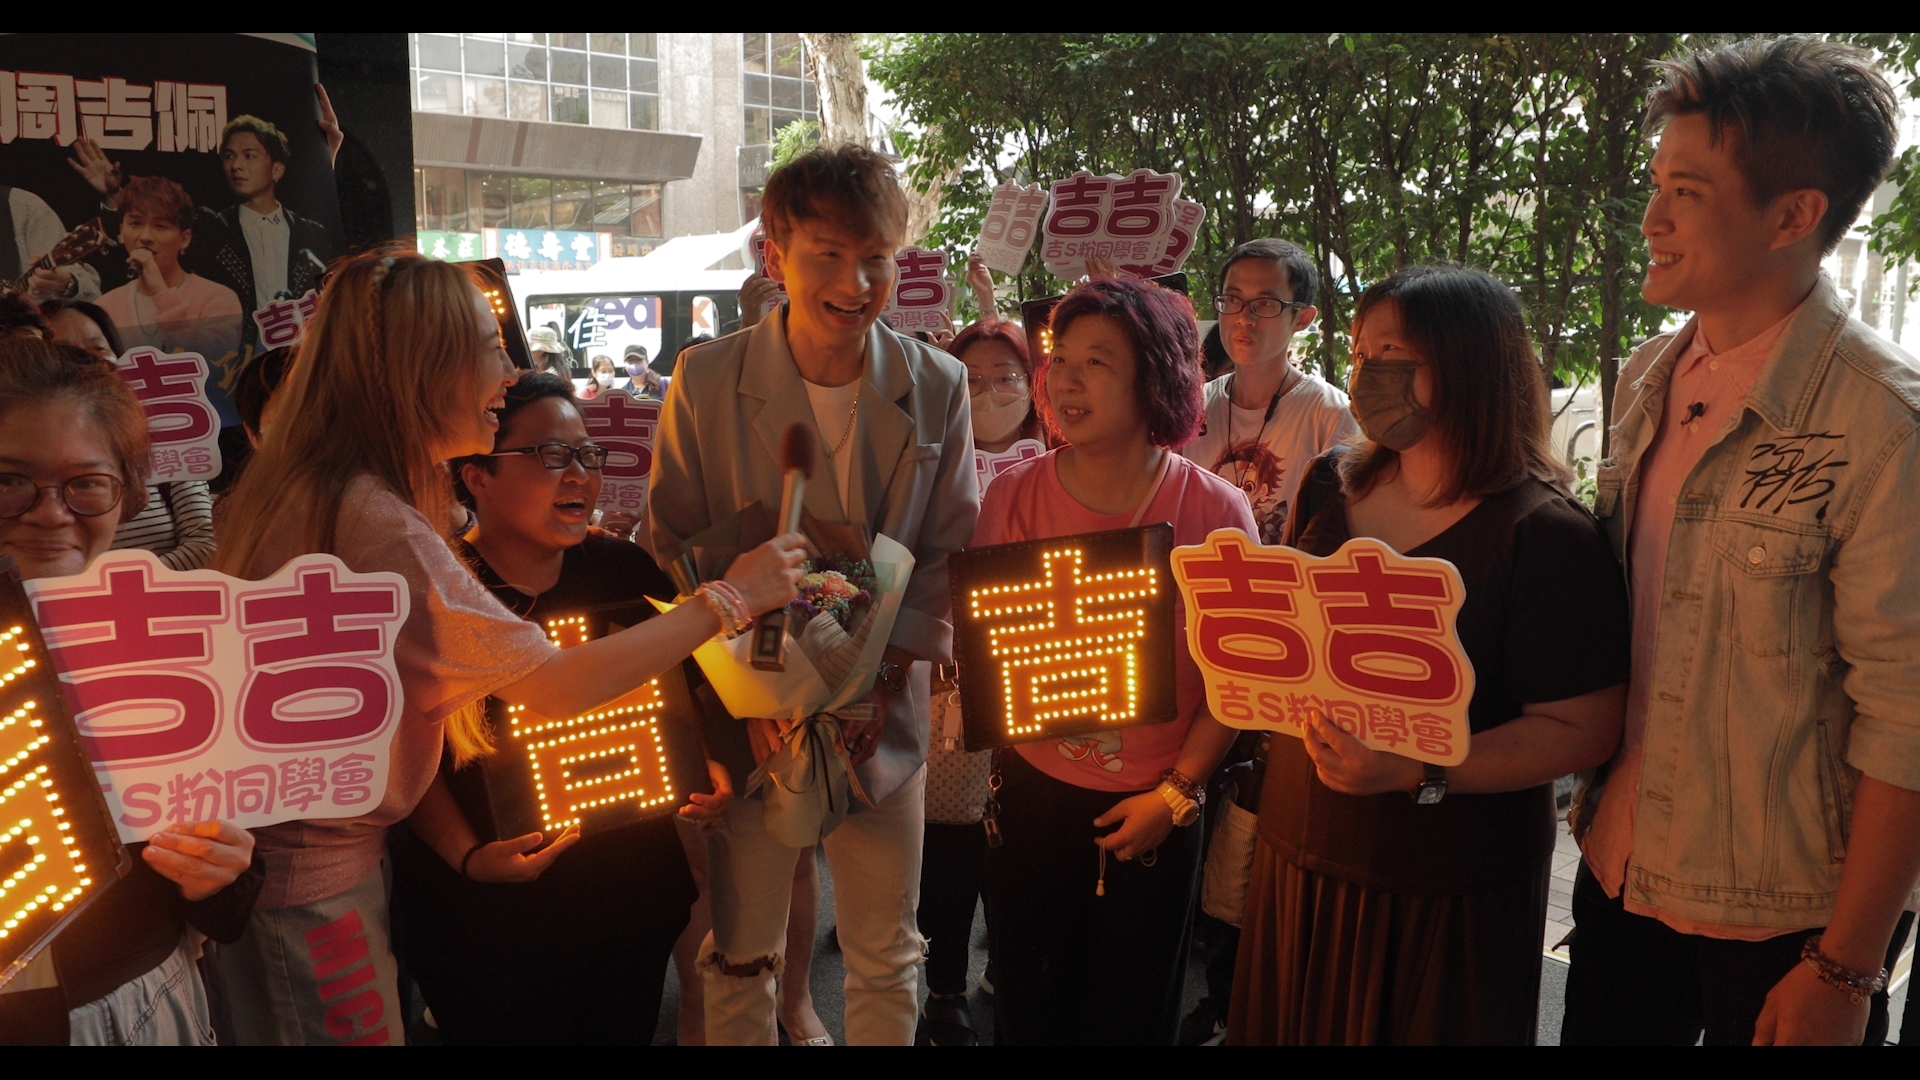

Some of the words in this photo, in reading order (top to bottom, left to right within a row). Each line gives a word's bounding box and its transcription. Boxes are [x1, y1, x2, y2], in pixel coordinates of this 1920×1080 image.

[981, 182, 1046, 250] 吉吉
[1048, 174, 1169, 236] 吉吉
[895, 251, 943, 308] 吉
[568, 308, 609, 350] 佳
[143, 446, 213, 478] 學會
[581, 397, 659, 478] 吉
[1184, 543, 1463, 703] 吉吉
[36, 569, 396, 764] 吉吉
[1216, 680, 1455, 757] 吉S粉同學會
[102, 752, 375, 828] S粉同學會
